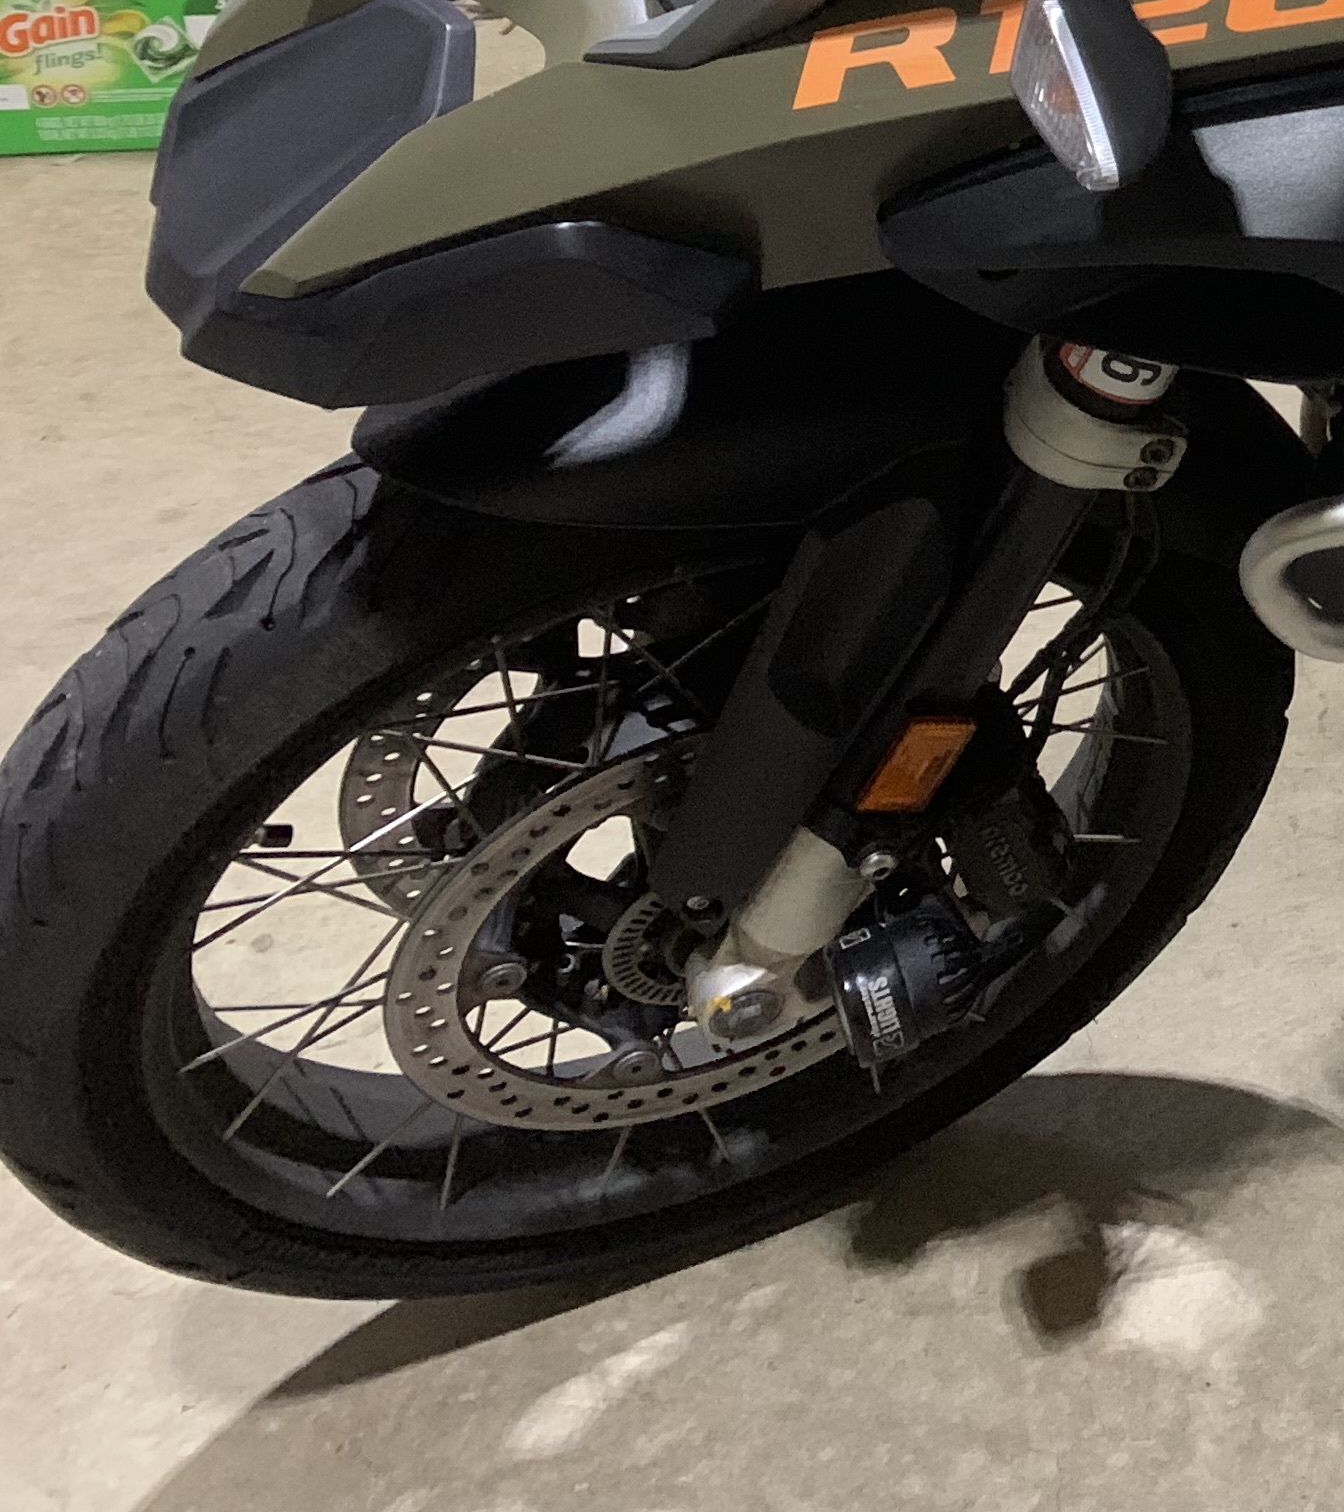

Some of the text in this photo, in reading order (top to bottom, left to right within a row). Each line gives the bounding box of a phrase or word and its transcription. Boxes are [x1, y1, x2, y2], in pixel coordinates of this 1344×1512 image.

[0, 6, 96, 53] Gain
[33, 42, 103, 75] flings!
[868, 976, 901, 1036] LIGHTS
